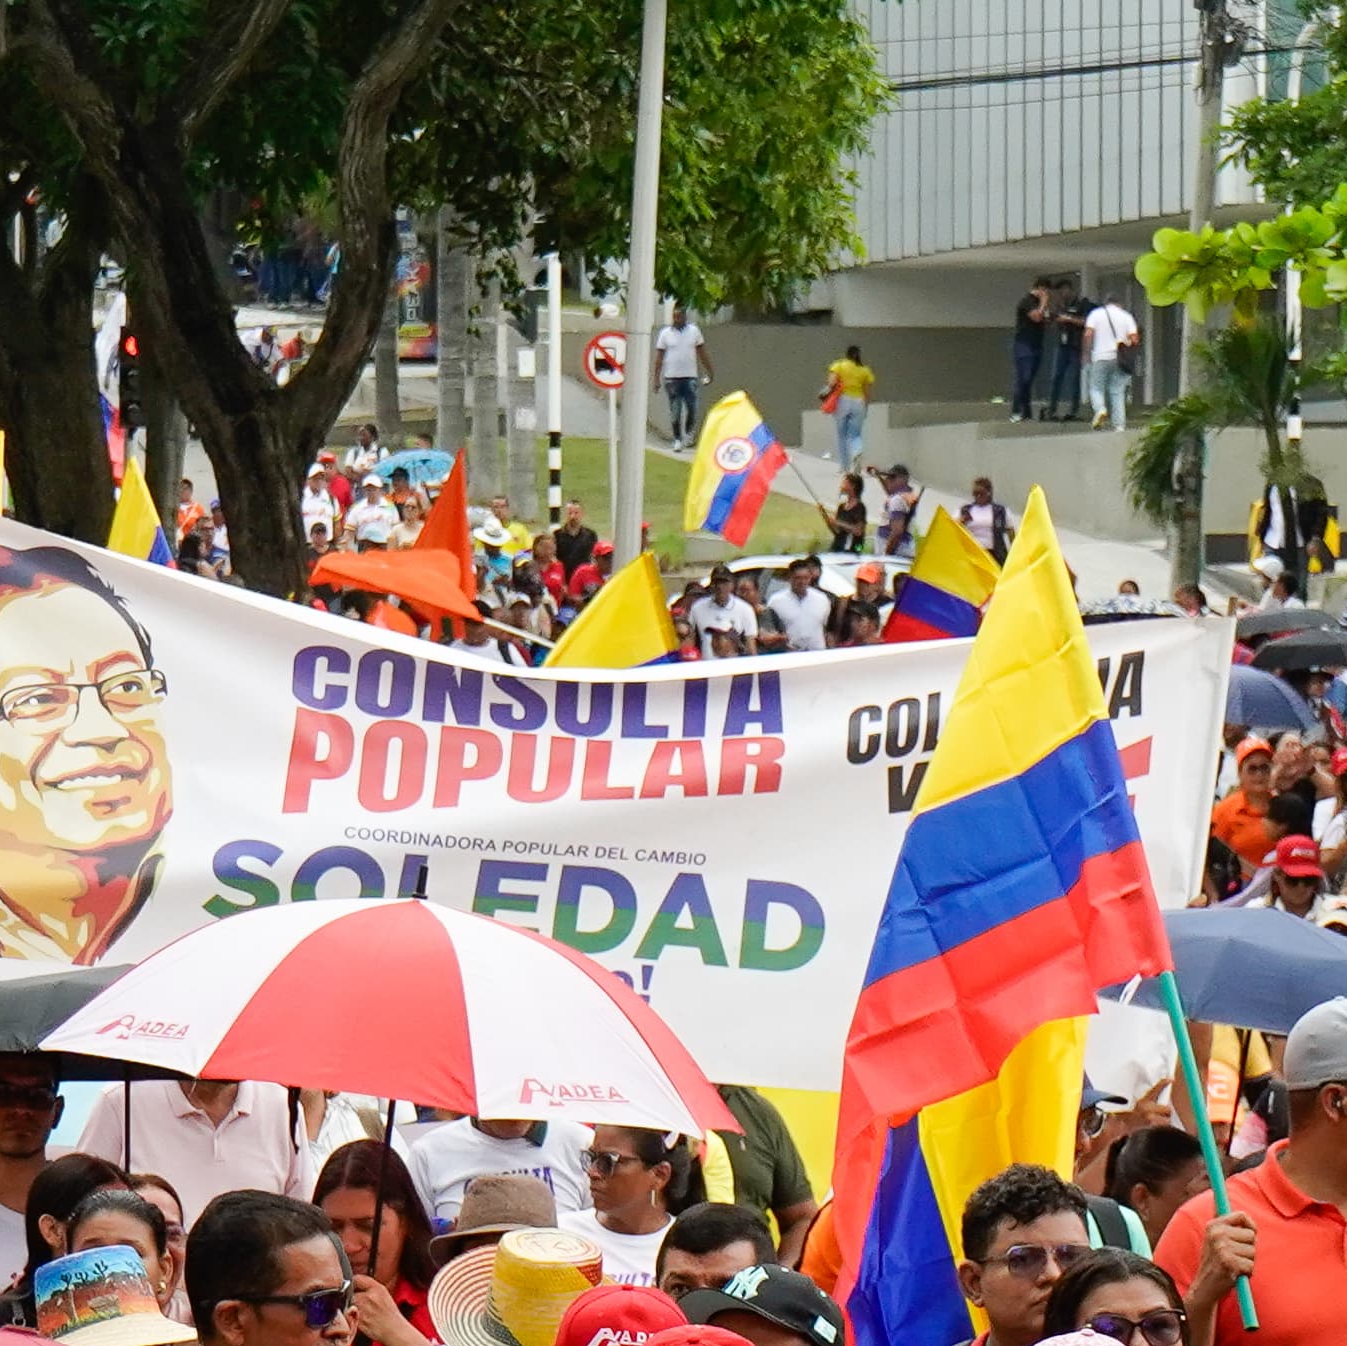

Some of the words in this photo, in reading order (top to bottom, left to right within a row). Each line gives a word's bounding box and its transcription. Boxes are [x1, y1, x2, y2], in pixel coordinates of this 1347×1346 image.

[282, 707, 786, 814] POPULAR
[344, 825, 496, 853] COORDINADORA
[502, 838, 589, 859] POPULAR
[595, 847, 629, 861] DEL
[634, 848, 707, 866] CAMBIO
